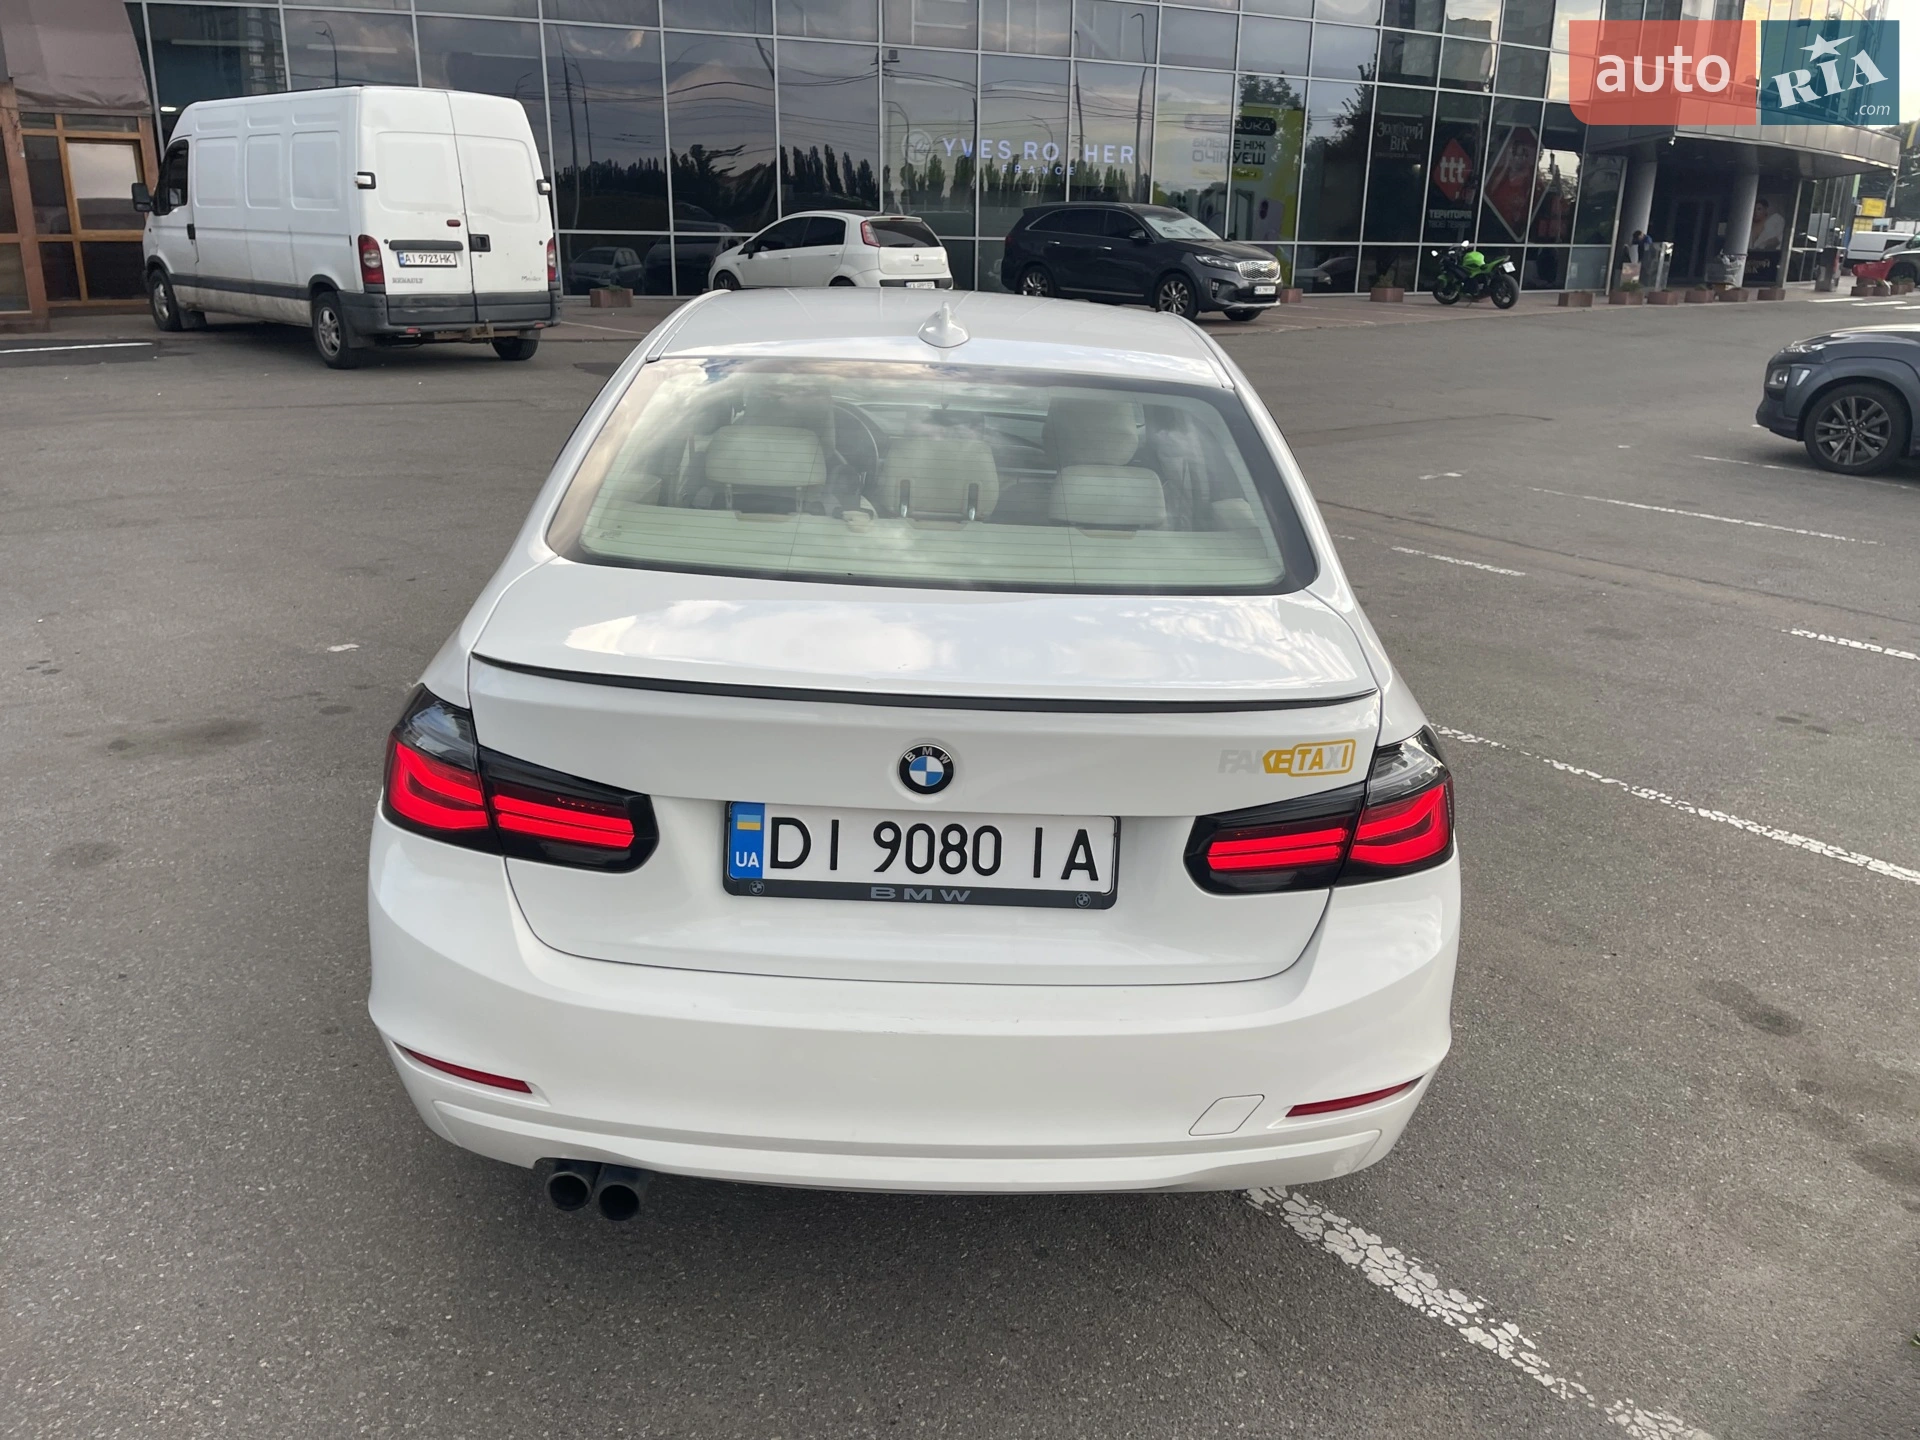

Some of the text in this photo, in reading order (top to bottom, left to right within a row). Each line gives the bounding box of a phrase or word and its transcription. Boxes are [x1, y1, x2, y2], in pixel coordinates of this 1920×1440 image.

[943, 138, 1134, 164] YVES ROHER
[1243, 141, 1266, 151] НІЖ
[1002, 164, 1076, 176] FRANCE
[1440, 156, 1466, 183] ttt
[418, 254, 439, 264] 9723
[904, 746, 951, 765] BMW
[770, 816, 1099, 882] DI 9080 IA
[735, 851, 760, 868] UA
[870, 886, 971, 903] BMW
